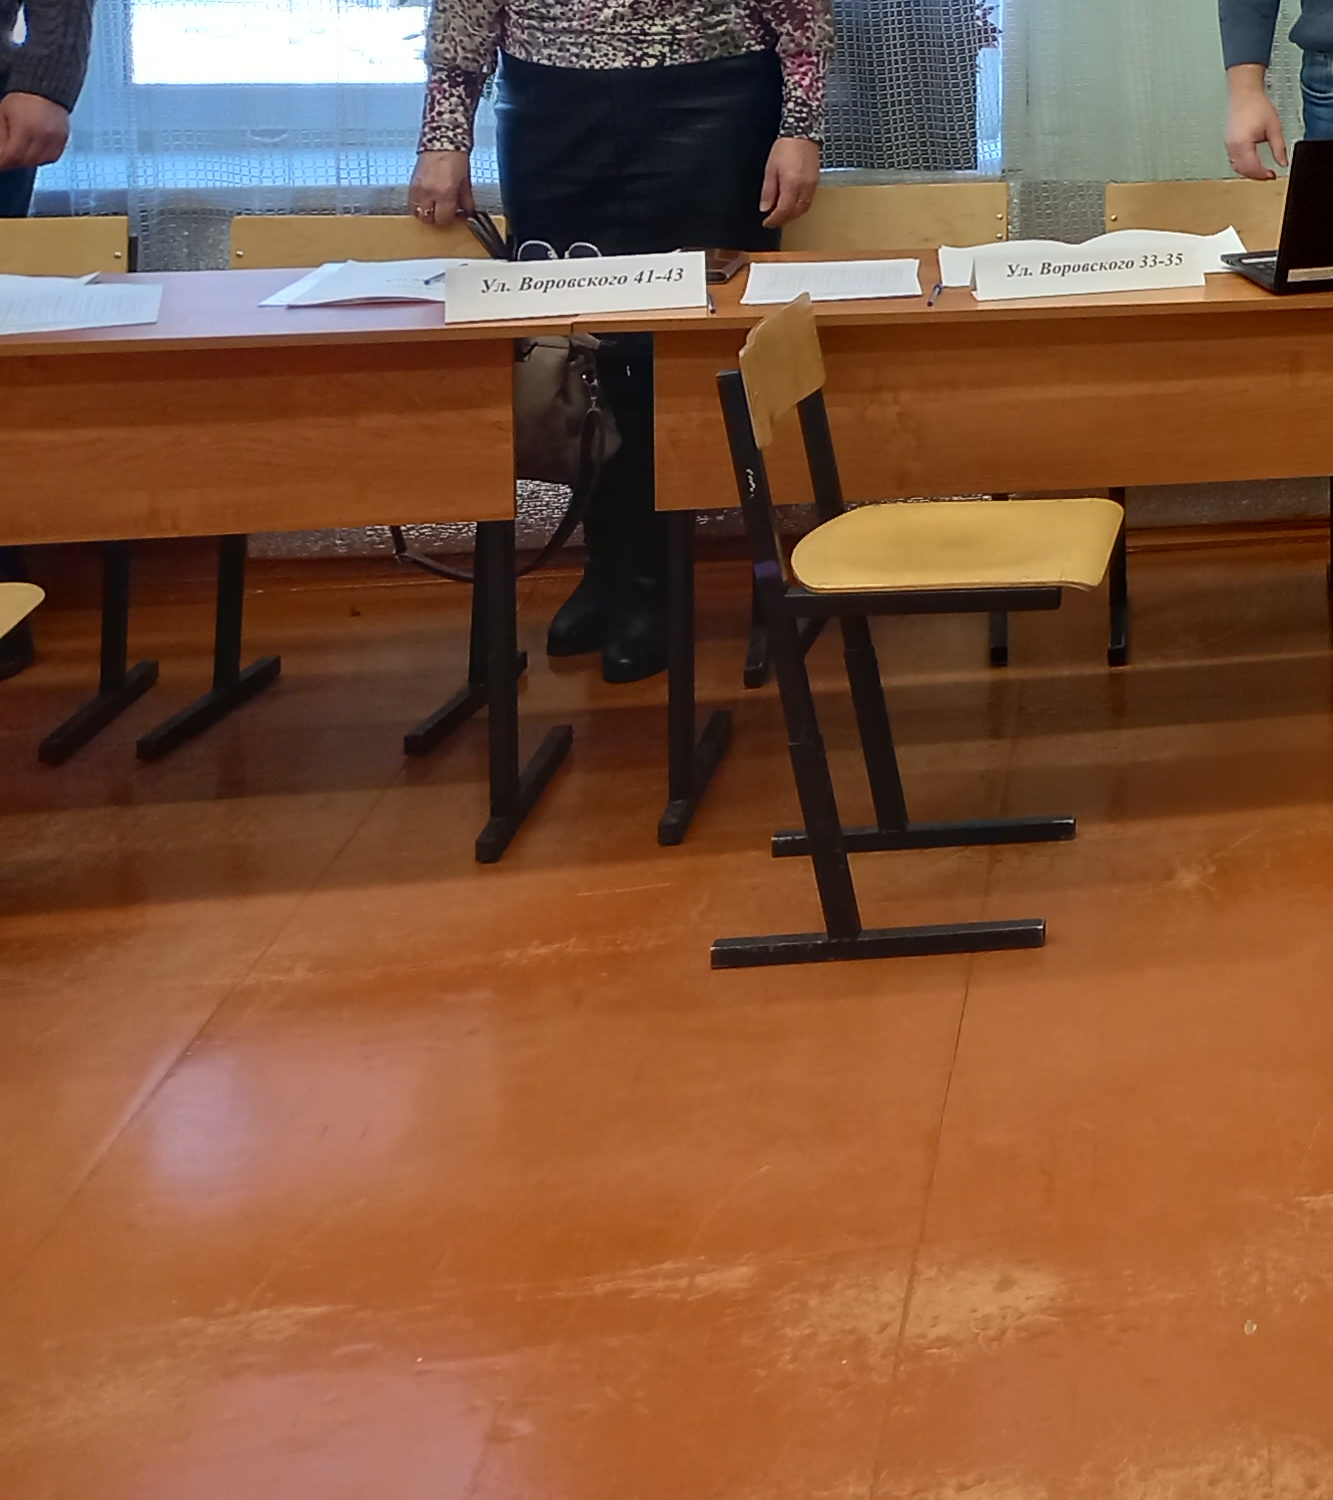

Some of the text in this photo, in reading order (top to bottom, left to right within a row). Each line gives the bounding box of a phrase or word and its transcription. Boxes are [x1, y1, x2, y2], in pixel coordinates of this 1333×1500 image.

[1006, 252, 1184, 279] Ул. Воровского 33-35
[481, 267, 685, 294] Ул. Воровского 41-43
